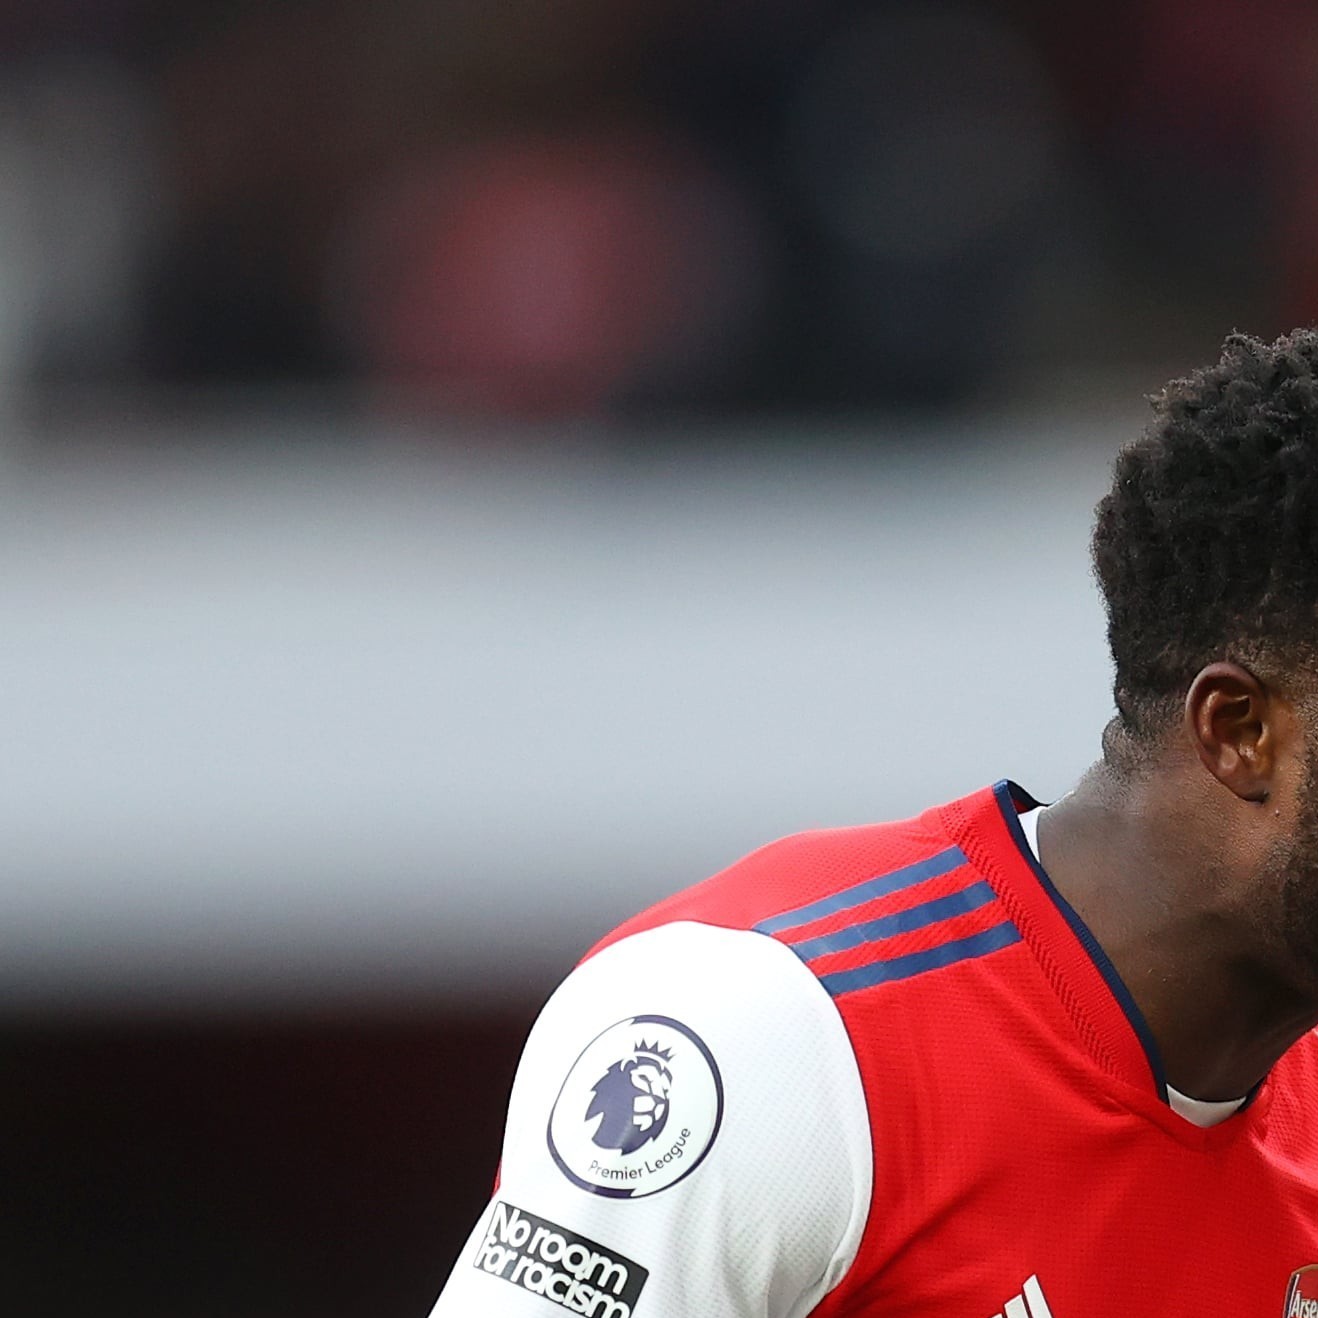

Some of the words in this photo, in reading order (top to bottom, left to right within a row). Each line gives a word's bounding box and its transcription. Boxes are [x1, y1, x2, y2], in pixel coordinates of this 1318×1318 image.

[589, 1159, 643, 1181] Premier
[646, 1126, 692, 1174] League
[474, 1233, 519, 1278] for
[486, 1203, 531, 1249] No
[528, 1225, 629, 1296] room
